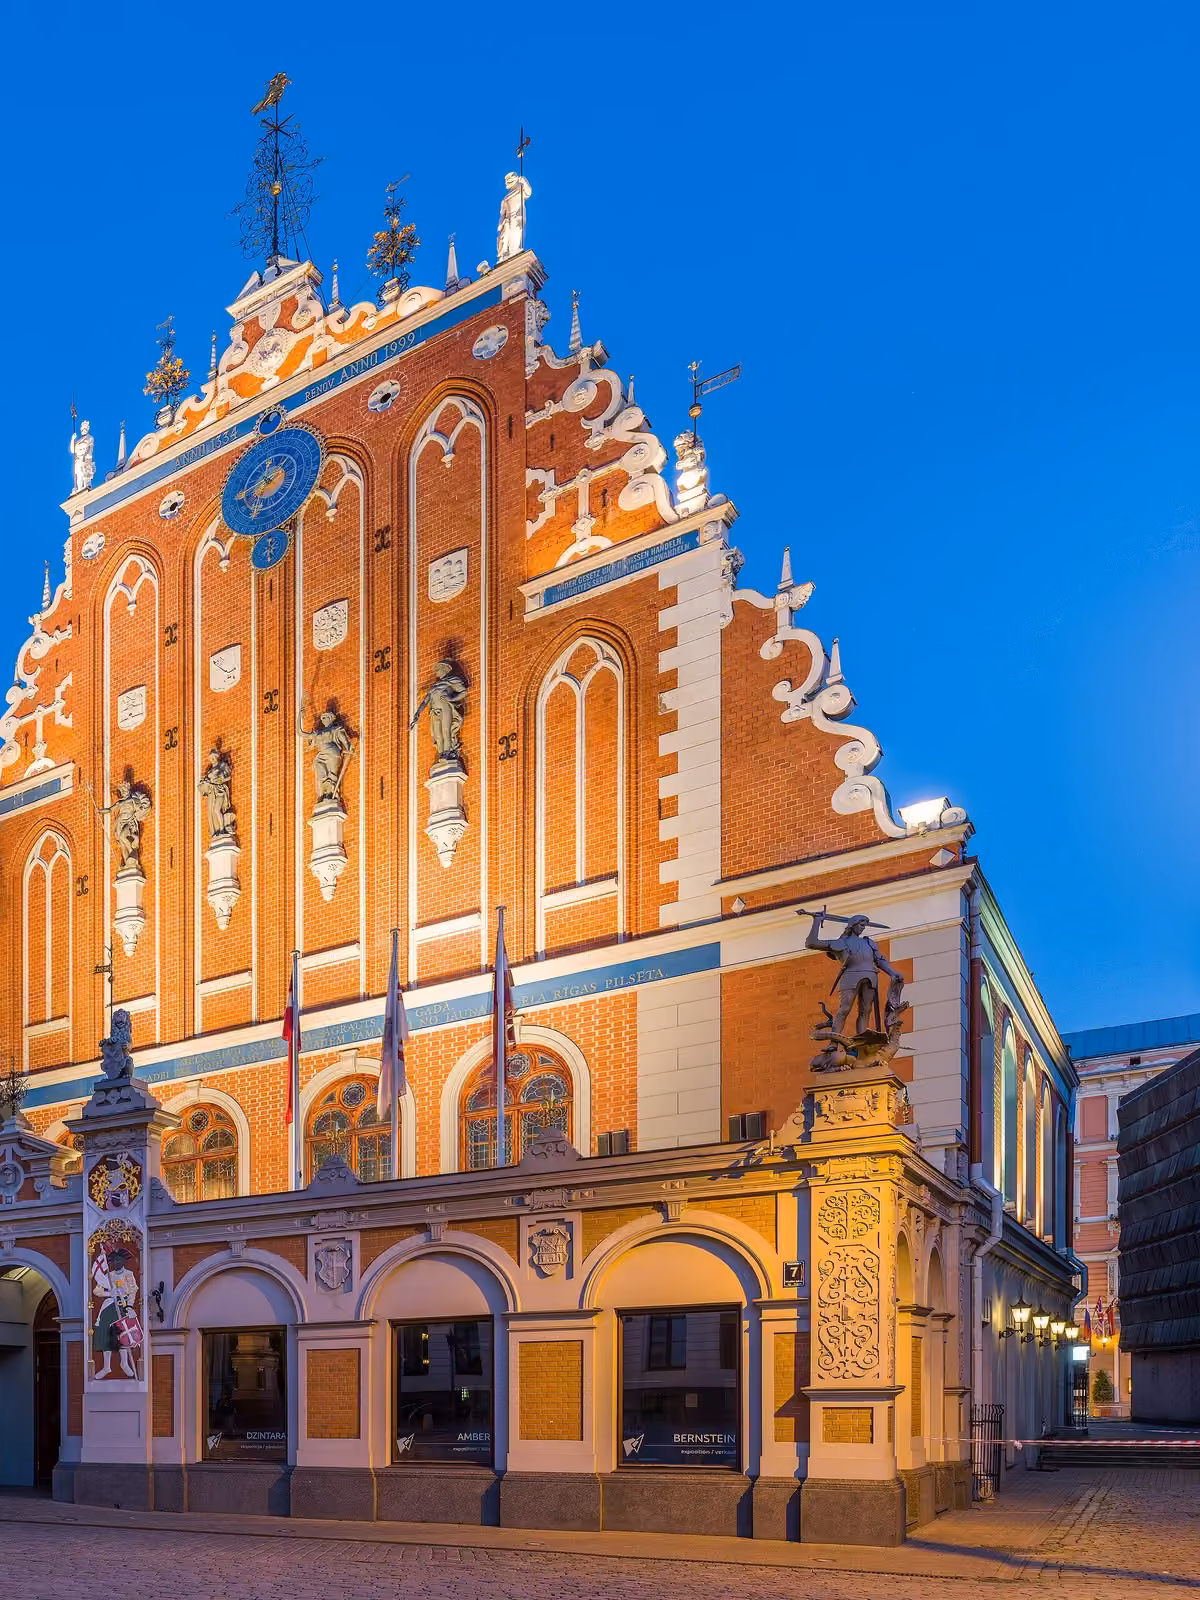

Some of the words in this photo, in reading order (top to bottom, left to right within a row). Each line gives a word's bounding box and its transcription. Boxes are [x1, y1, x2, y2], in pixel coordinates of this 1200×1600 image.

[340, 351, 378, 383] ANNO
[384, 332, 416, 360] 1999
[790, 1266, 798, 1278] 7
[456, 1432, 491, 1441] AMBER
[673, 1433, 736, 1443] BERNSTEIN
